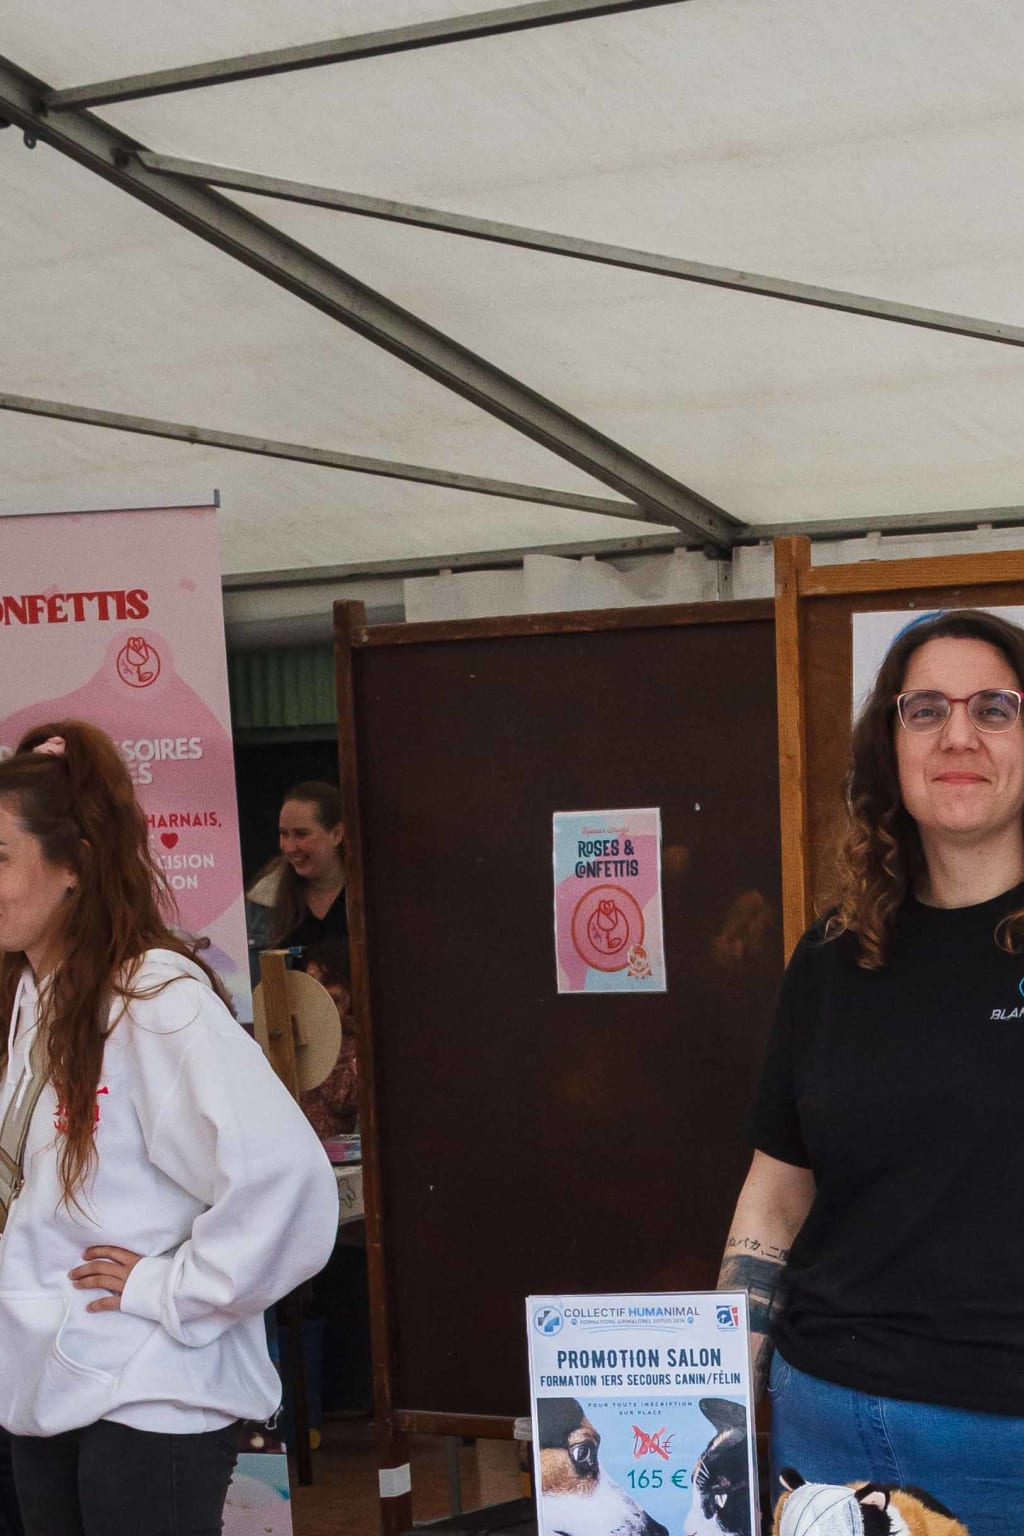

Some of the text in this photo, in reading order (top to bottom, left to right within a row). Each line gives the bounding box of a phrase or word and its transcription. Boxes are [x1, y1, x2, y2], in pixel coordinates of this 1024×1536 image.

[113, 737, 204, 762] SOIRES
[578, 839, 634, 858] ROSES &
[575, 860, 638, 878] CONFETTIS
[564, 1307, 700, 1318] COLLECTIF HUMANIMAL
[557, 1348, 722, 1369] PROMOTION SALON
[540, 1370, 741, 1387] FORMATION 1ERS SECOURS CANIN/FÉLIN
[627, 1468, 688, 1489] 165 €
